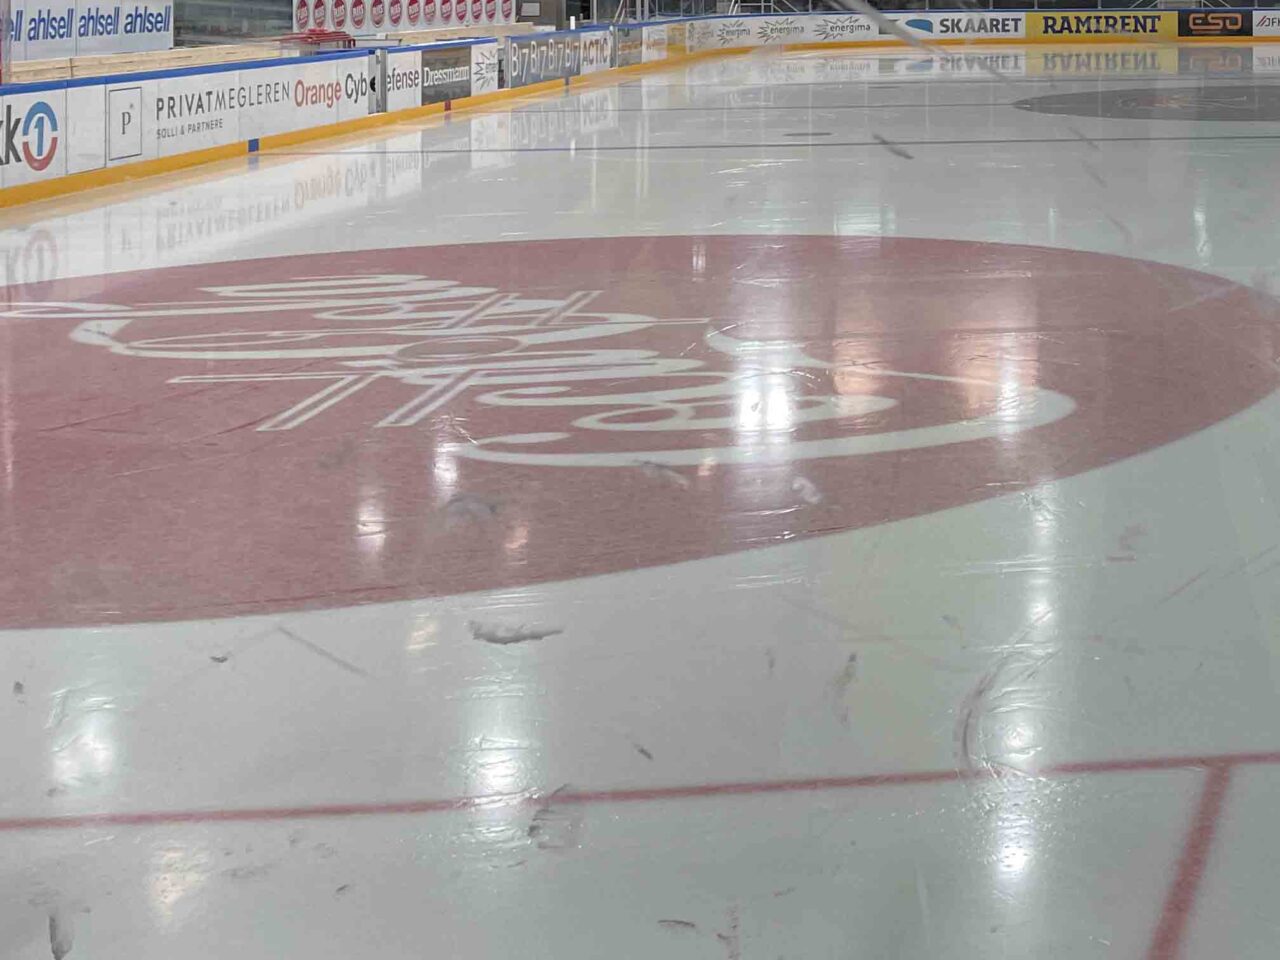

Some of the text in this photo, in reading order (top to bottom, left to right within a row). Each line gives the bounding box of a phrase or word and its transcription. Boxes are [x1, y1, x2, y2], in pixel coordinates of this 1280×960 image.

[28, 8, 74, 40] ahlsell
[78, 6, 120, 36] ahlsell
[124, 5, 171, 34] ahlsell
[770, 25, 804, 35] energima
[829, 25, 871, 34] energima
[1042, 16, 1161, 34] RAMIRENT
[156, 81, 290, 121] PRIVATMEGLEREN
[295, 80, 342, 108] Orange
[157, 126, 177, 139] SOLLI
[187, 119, 224, 134] PARTNERE
